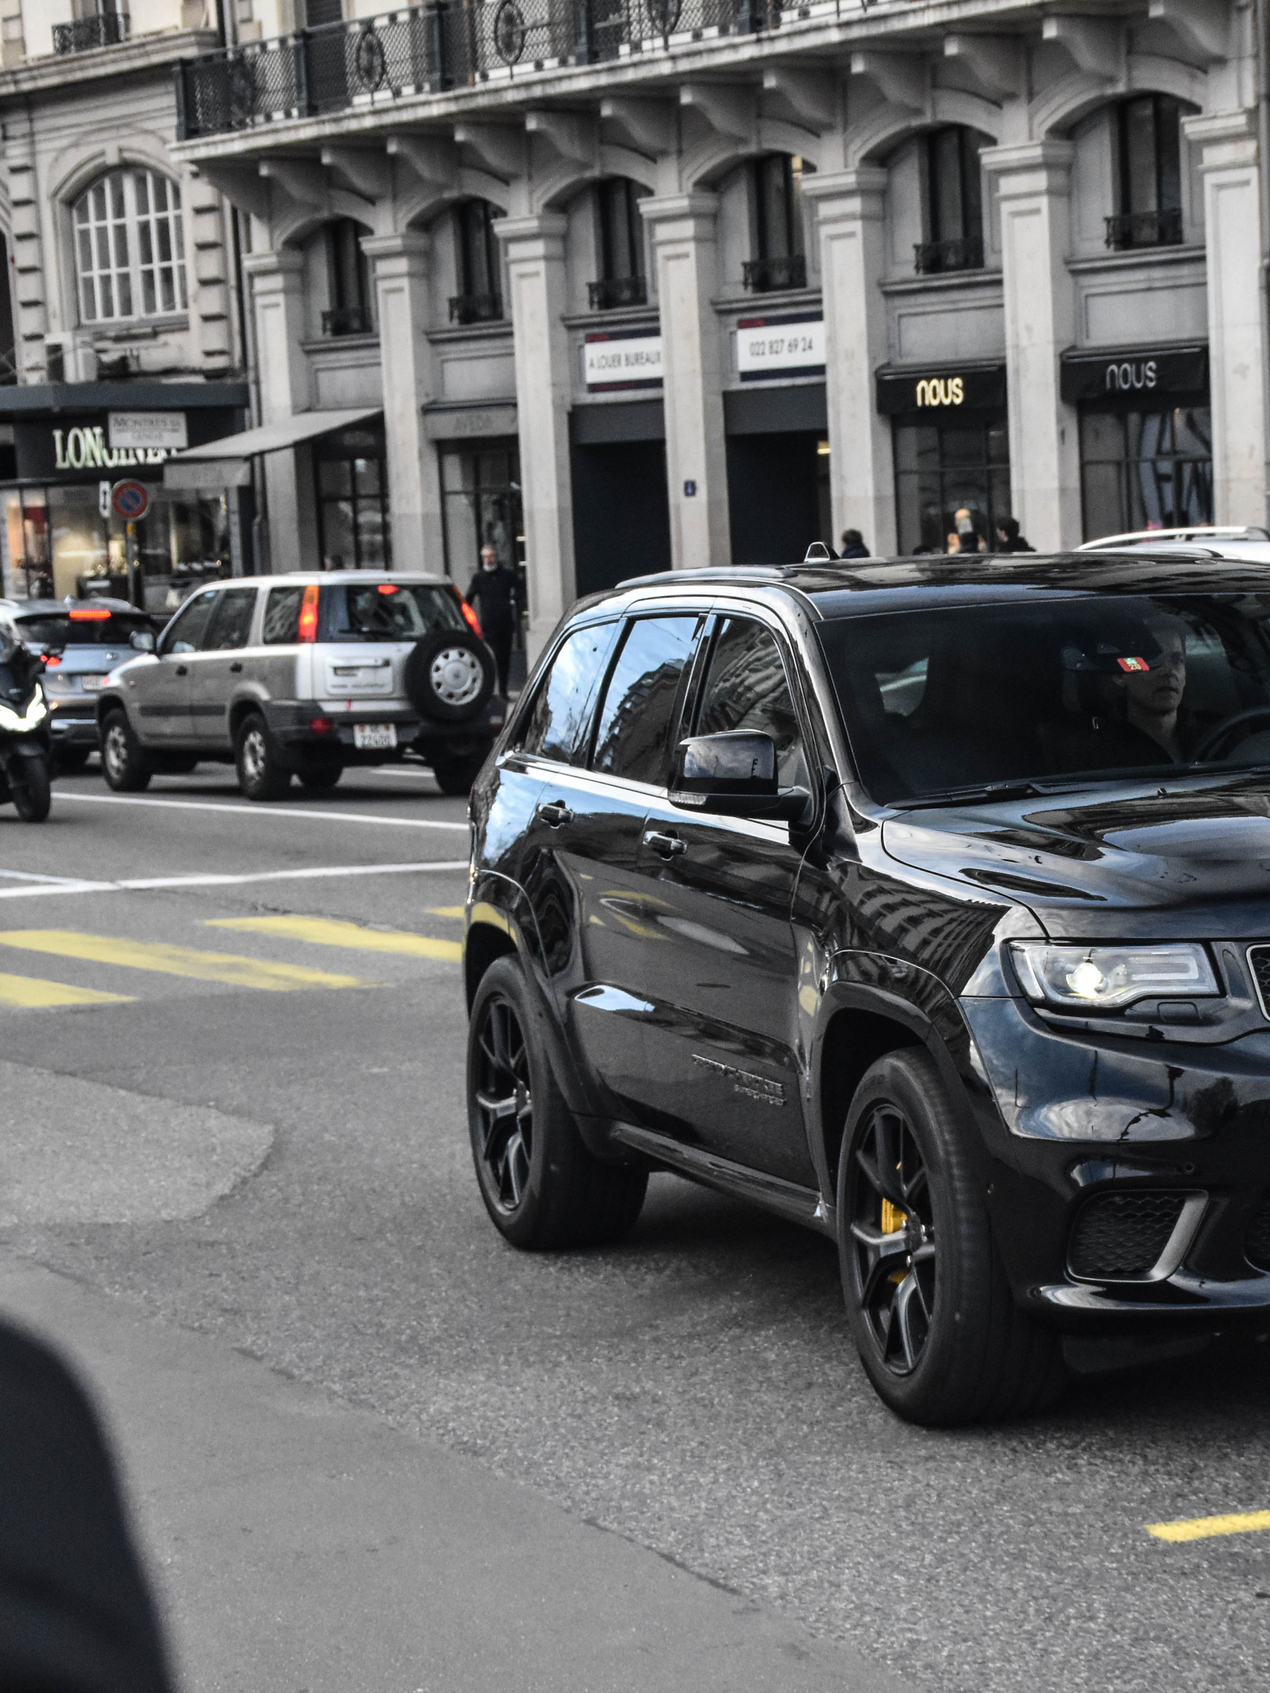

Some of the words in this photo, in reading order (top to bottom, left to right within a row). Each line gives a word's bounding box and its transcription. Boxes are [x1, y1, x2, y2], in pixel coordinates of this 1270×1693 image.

[750, 341, 766, 357] 022
[768, 338, 785, 354] 827
[787, 336, 800, 352] 69
[801, 335, 814, 352] 24
[588, 356, 596, 369] A
[597, 353, 622, 370] LOUER
